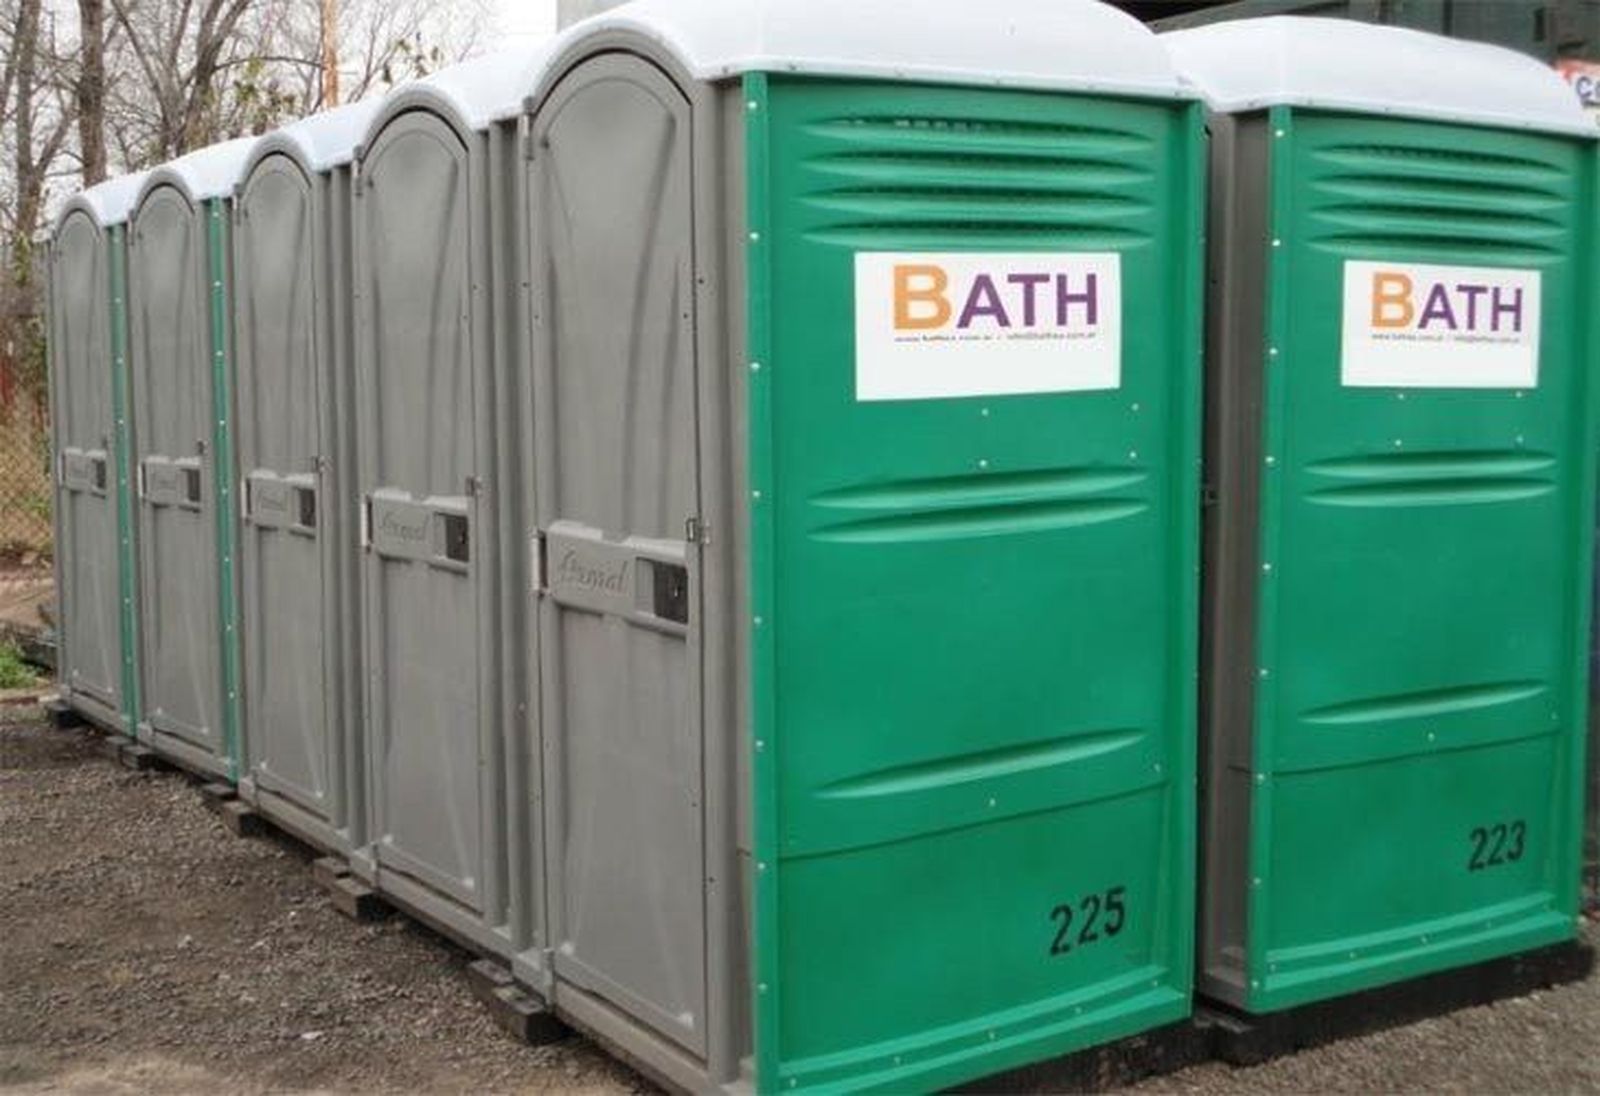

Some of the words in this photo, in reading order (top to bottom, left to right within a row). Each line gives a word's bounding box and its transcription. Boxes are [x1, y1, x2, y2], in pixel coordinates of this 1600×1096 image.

[894, 264, 1097, 330] BATH
[1371, 272, 1522, 332] BATH
[1468, 819, 1526, 873] 223
[1049, 885, 1126, 956] 225
